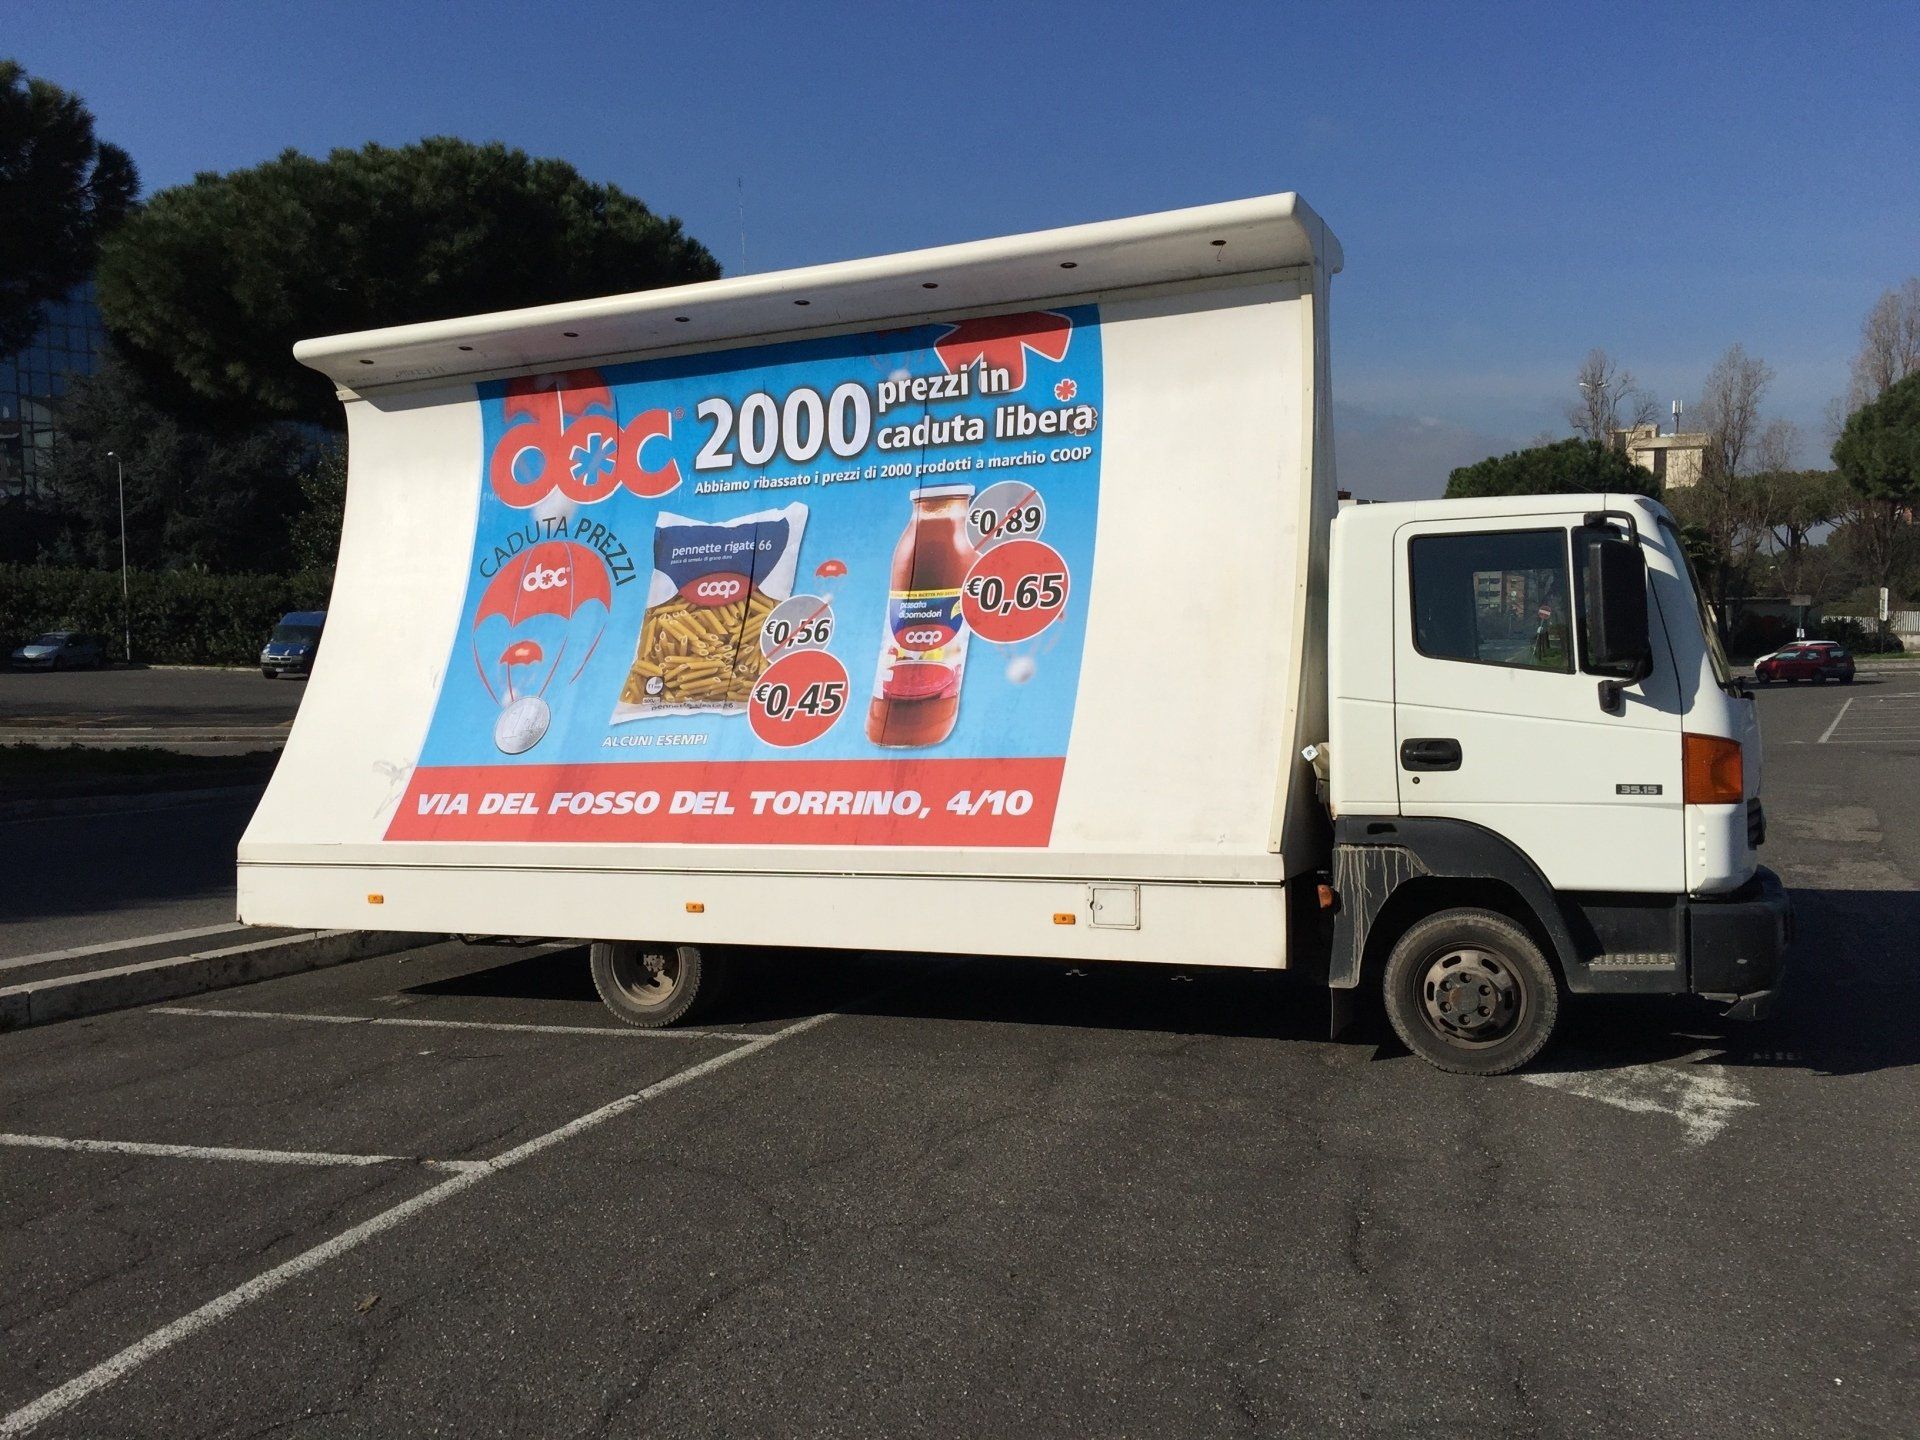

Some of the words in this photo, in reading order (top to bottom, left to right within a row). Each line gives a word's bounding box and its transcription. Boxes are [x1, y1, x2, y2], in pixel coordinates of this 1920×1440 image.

[877, 366, 969, 413] prezzi
[978, 362, 1010, 394] in
[694, 382, 872, 470] 2000
[877, 415, 985, 451] caduta
[995, 404, 1094, 439] libera
[694, 478, 751, 495] Abbiamo
[753, 472, 812, 489] ribassato
[813, 470, 820, 484] i
[821, 467, 861, 486] prezzi
[863, 464, 877, 479] di
[880, 461, 913, 478] 2000
[914, 456, 973, 478] prodotti
[975, 457, 986, 470] a
[987, 450, 1046, 469] marchio
[1050, 446, 1093, 463] COOP
[969, 506, 1042, 539] €0,89
[479, 516, 569, 579] CADUTA
[574, 517, 637, 587] PREZZI
[671, 542, 722, 559] pennette
[724, 539, 756, 554] rigate
[758, 539, 773, 551] 66
[522, 563, 568, 593] doc
[697, 580, 741, 599] coop
[966, 574, 1064, 615] €0,65
[765, 617, 831, 649] €0,56
[905, 630, 943, 646] coop
[755, 682, 846, 722] €0,45
[602, 734, 653, 749] ALCUNI
[656, 733, 709, 748] ESEMPI
[416, 792, 470, 817] VIA
[477, 791, 540, 816] DEL
[547, 791, 662, 816] FOSSO
[669, 791, 736, 816] DEL
[748, 790, 932, 819] TORRINO,
[945, 789, 1034, 816] 4/10
